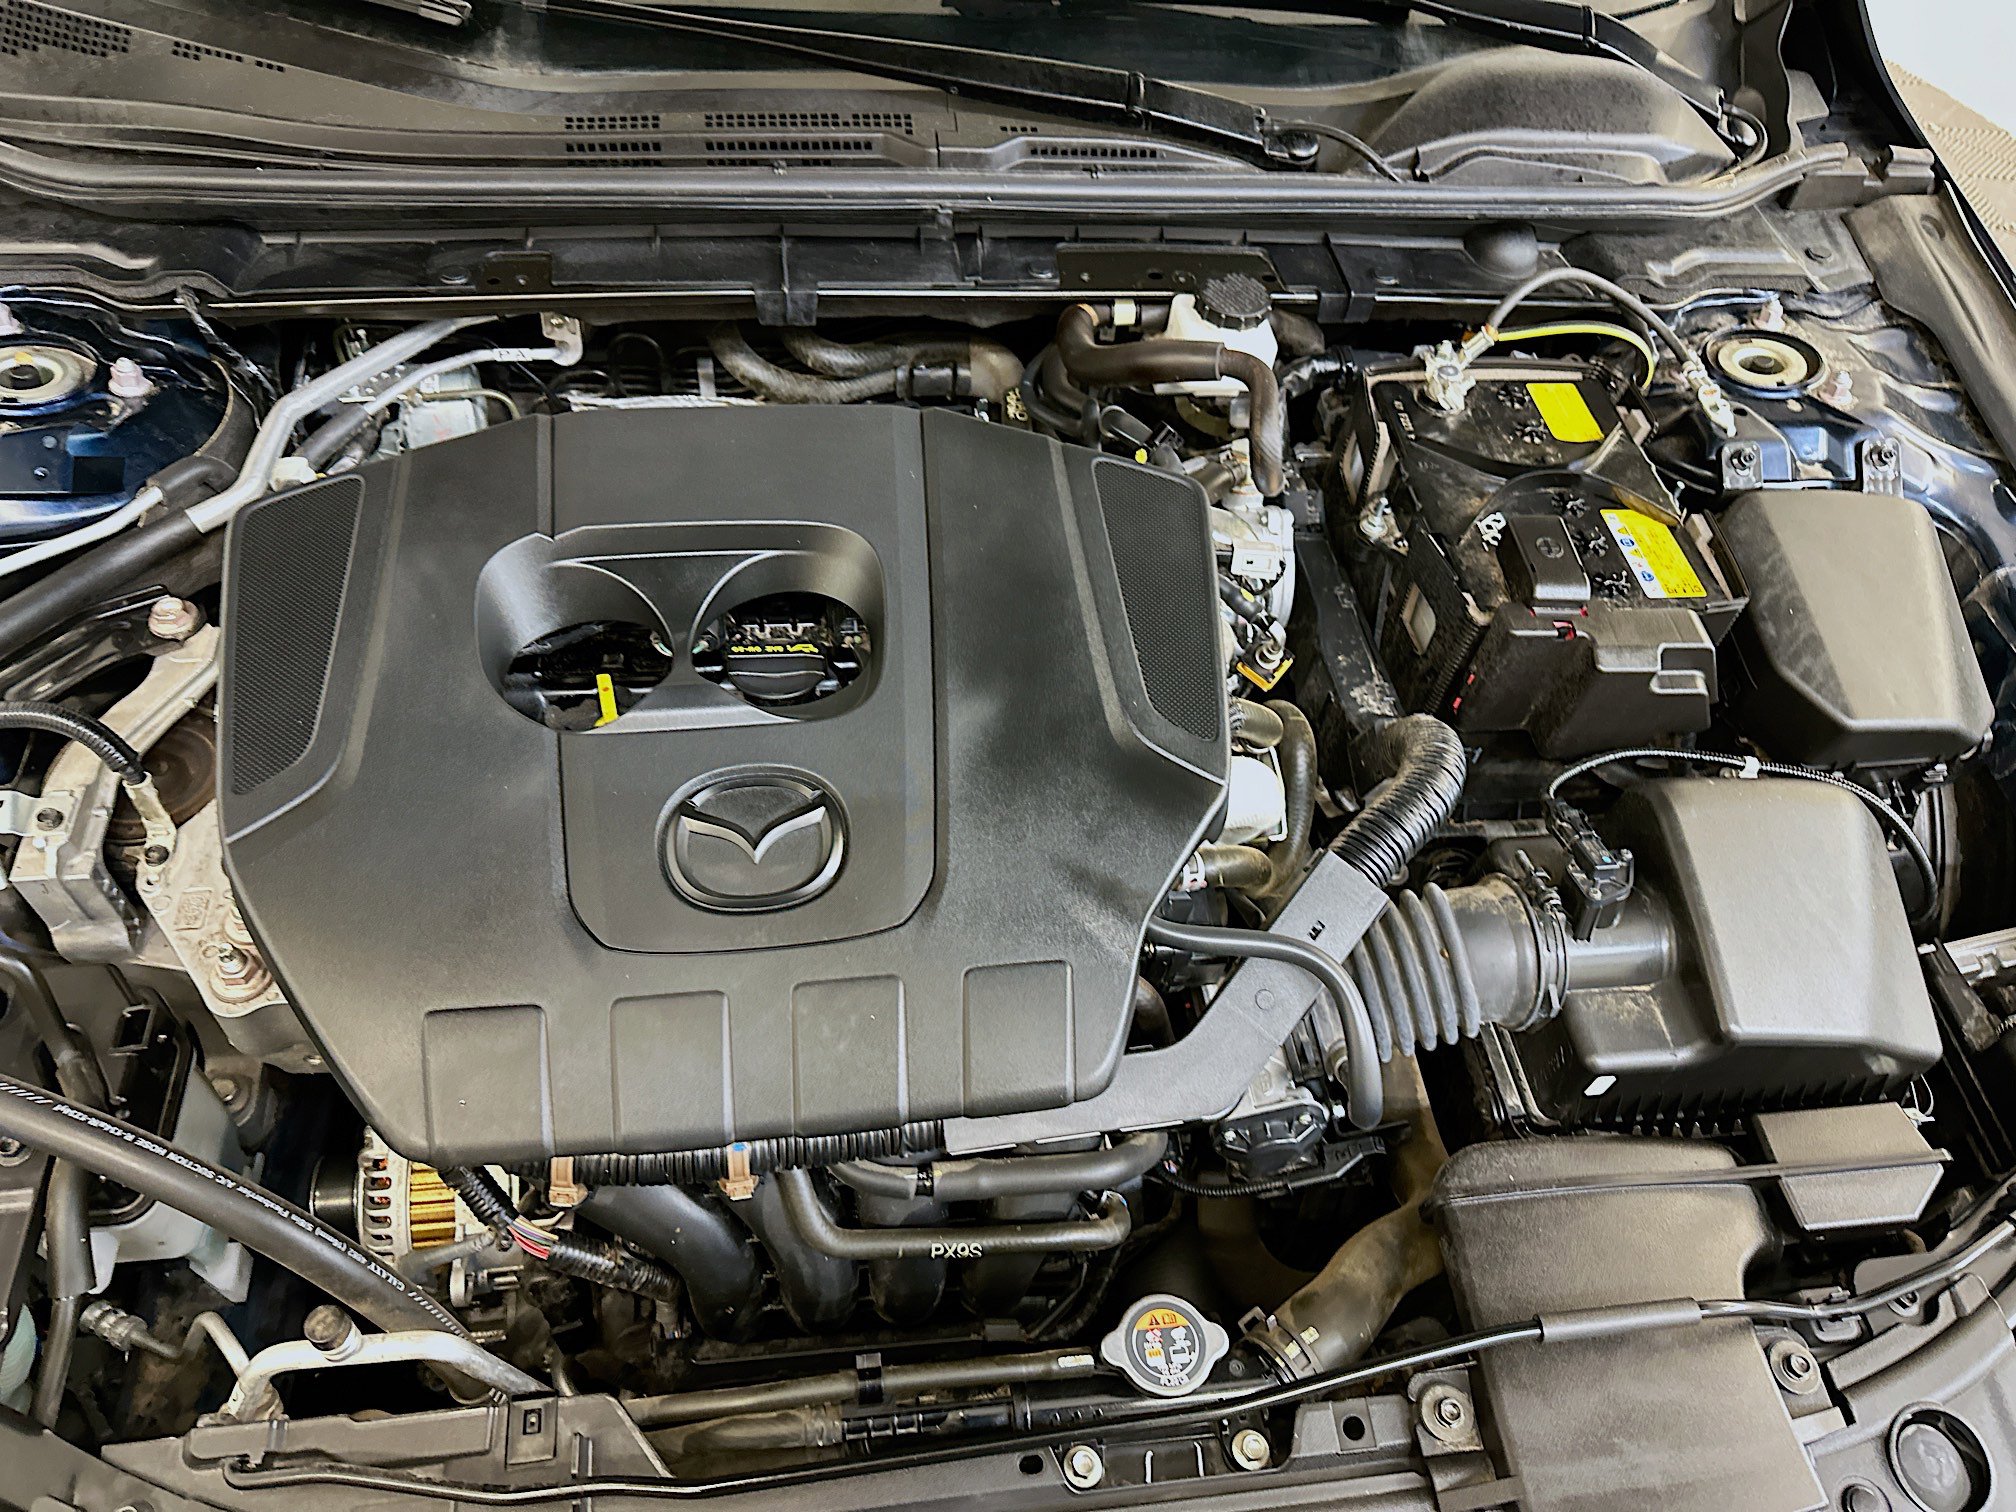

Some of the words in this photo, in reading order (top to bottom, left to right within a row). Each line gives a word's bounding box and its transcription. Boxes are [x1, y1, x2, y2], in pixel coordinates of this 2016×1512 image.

[133, 1137, 168, 1157] HOSE
[166, 1151, 216, 1179] SUCTION
[367, 1261, 406, 1292] GALAXY
